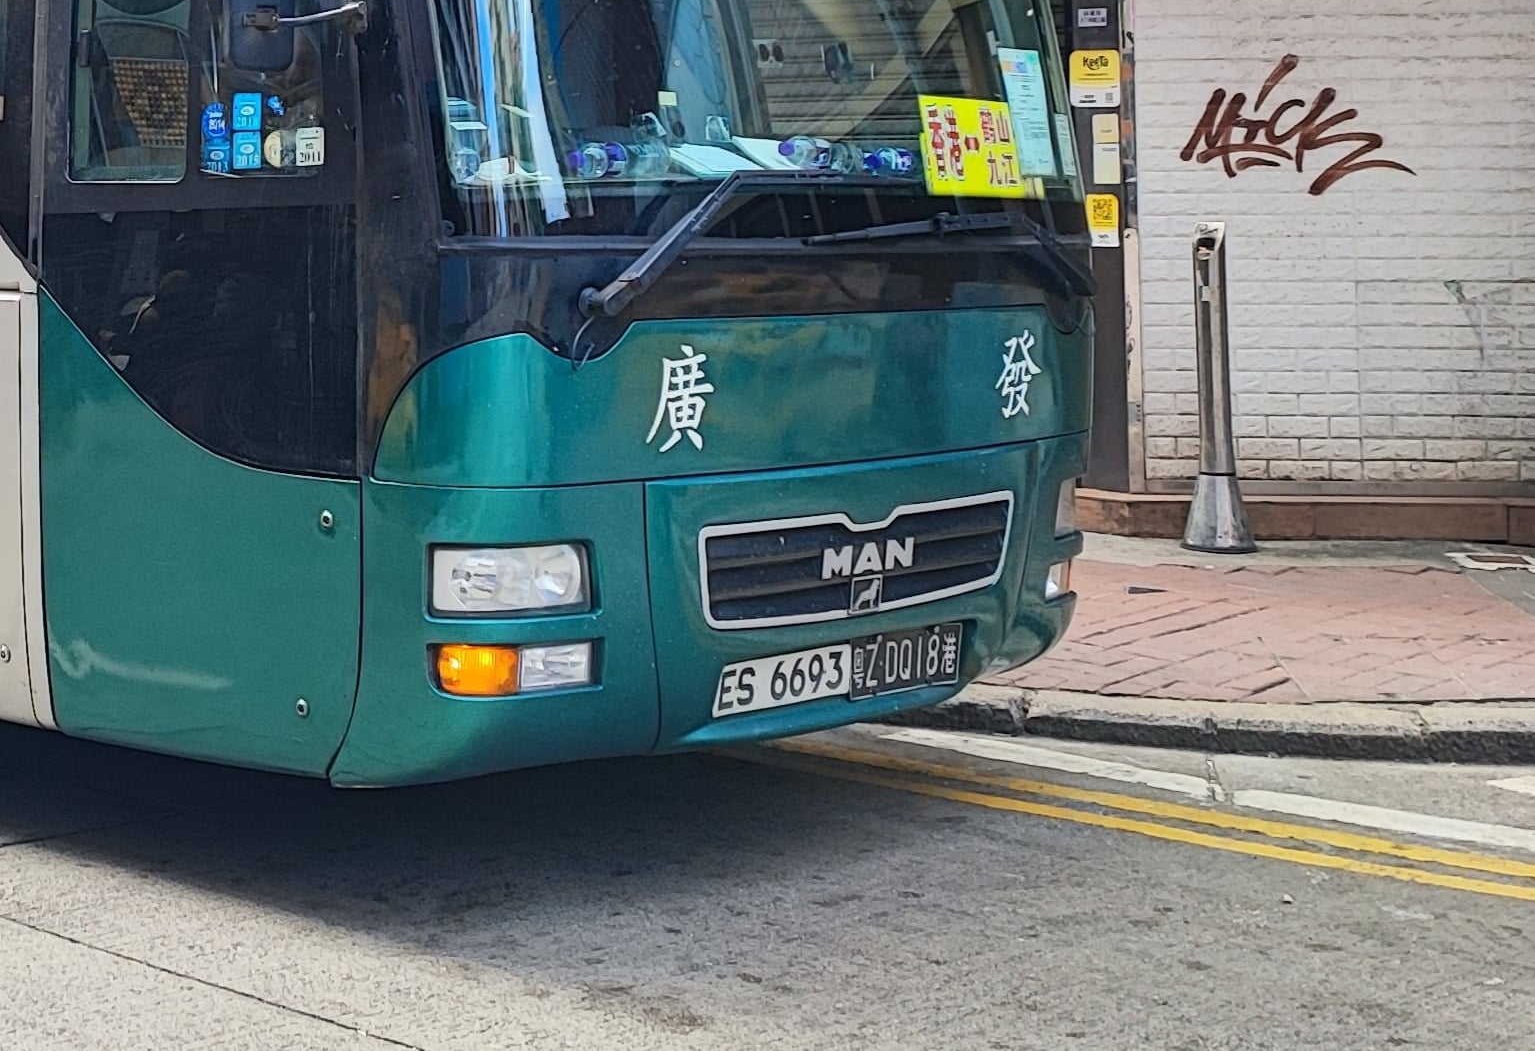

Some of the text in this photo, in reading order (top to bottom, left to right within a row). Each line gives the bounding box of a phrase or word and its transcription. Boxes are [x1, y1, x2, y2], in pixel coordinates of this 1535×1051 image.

[645, 344, 716, 453] 廣
[995, 329, 1042, 419] 發
[821, 537, 915, 580] MAN
[717, 650, 844, 712] ES 6693
